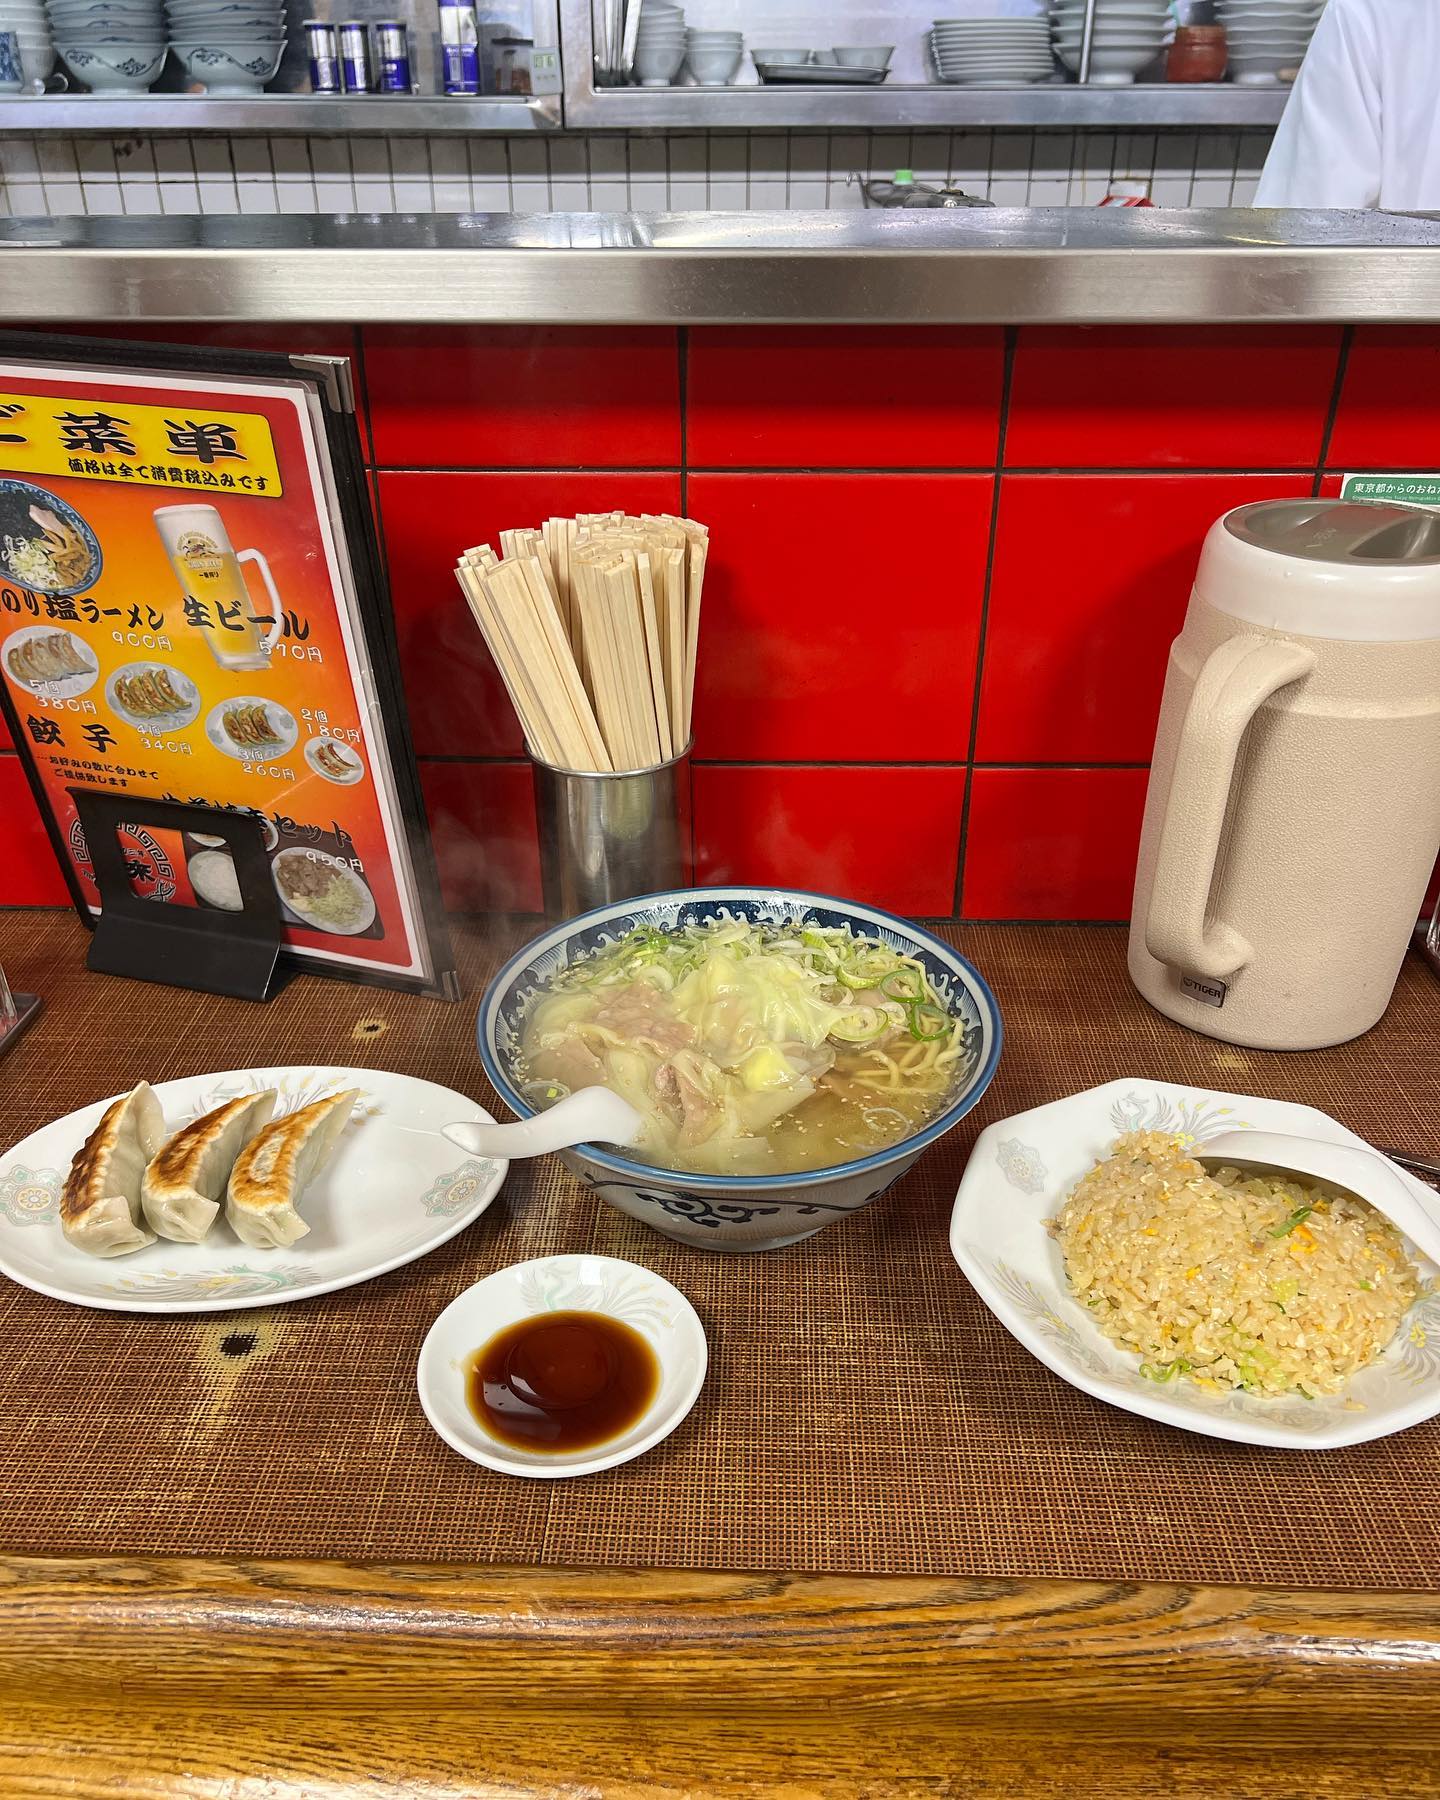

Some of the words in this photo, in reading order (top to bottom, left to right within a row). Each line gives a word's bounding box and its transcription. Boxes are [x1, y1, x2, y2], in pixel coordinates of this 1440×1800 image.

[68, 458, 268, 491] 価格は全て消費税込みです
[1354, 483, 1440, 494] 東京都からのおね
[183, 595, 309, 640] 生ビール
[112, 631, 172, 651] 900円
[259, 641, 323, 663] 570円
[35, 695, 97, 715] 380円
[26, 714, 117, 753] 餃子
[305, 723, 361, 743] 180円
[141, 738, 193, 755] 340円
[242, 762, 295, 781] 260円
[306, 851, 364, 873] 950円
[1193, 981, 1221, 998] TIGER
